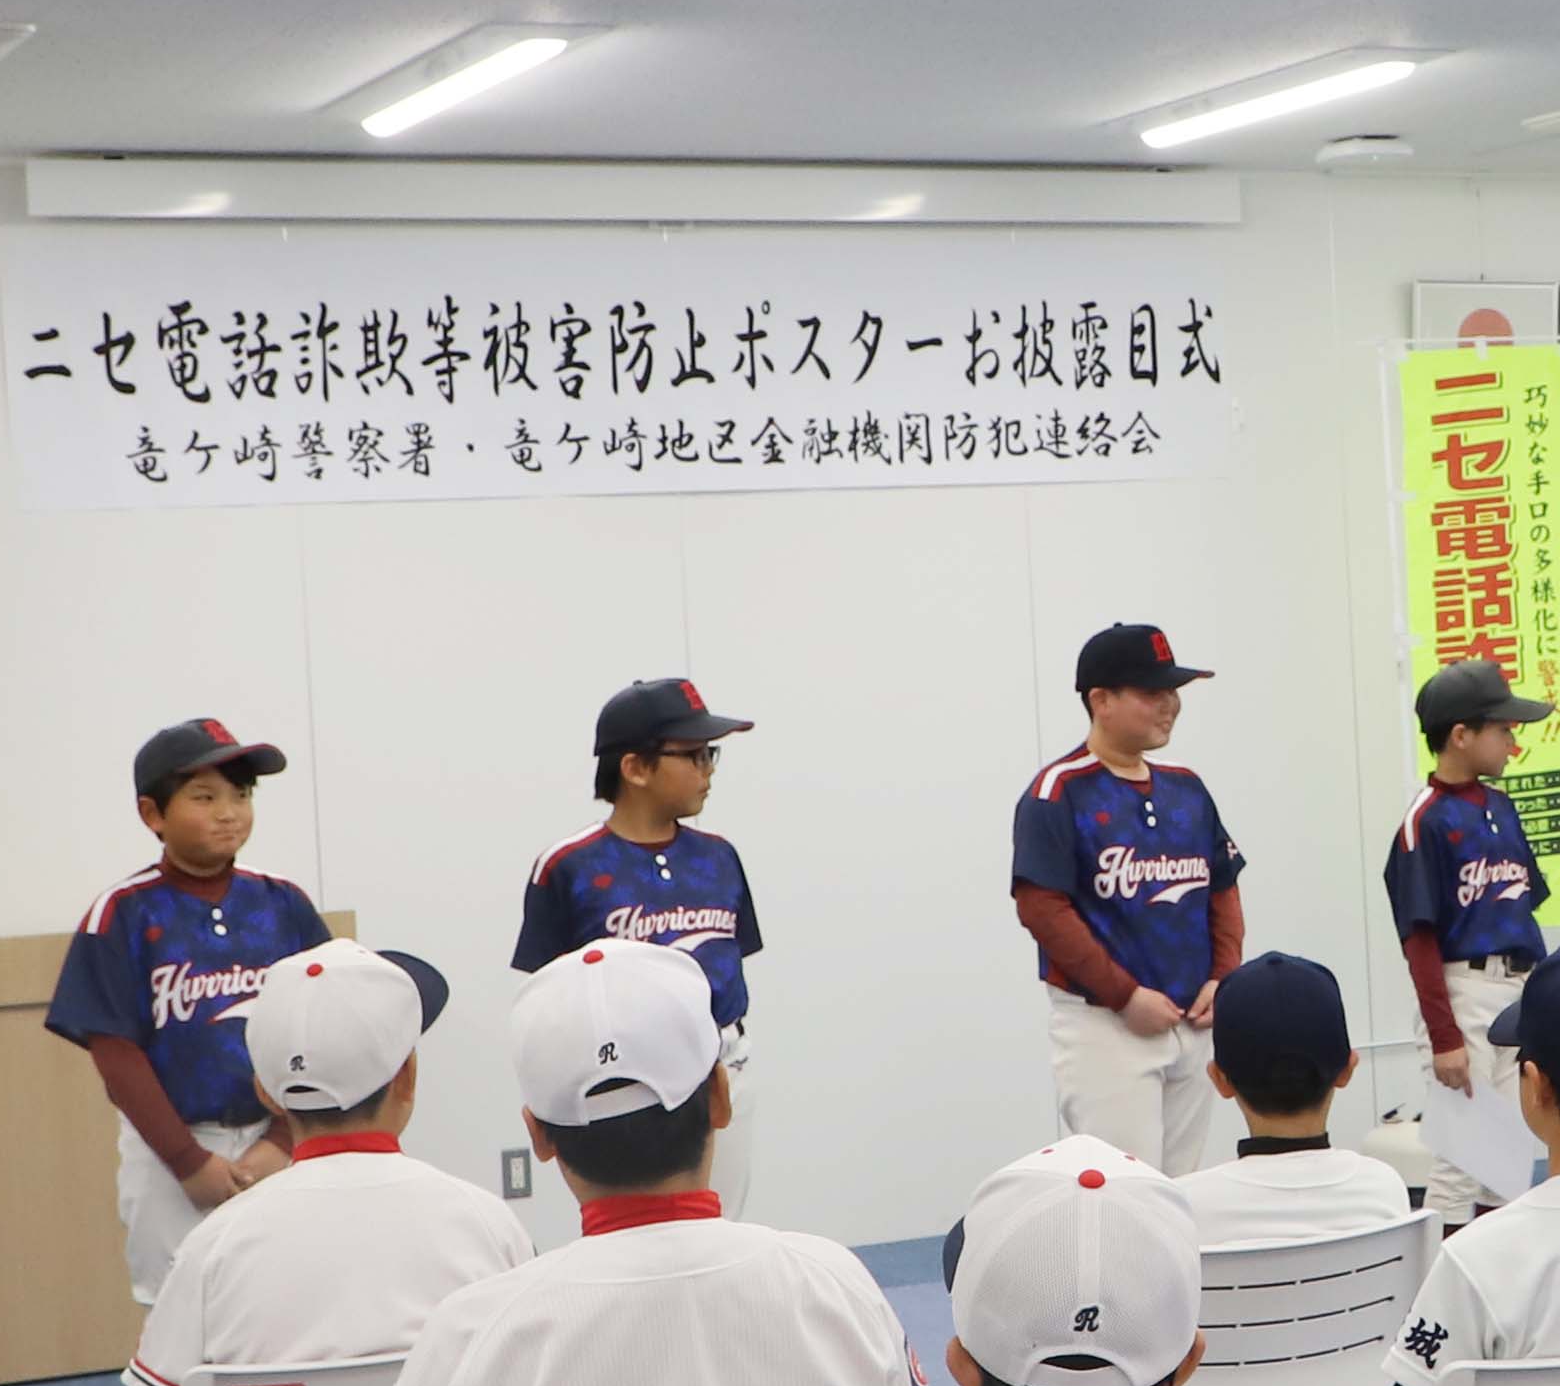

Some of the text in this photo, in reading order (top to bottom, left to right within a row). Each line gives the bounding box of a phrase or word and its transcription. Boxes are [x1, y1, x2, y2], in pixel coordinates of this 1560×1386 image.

[24, 295, 1222, 404] ニセ電話詐欺等被害防止ポスターお披露目式
[289, 1054, 306, 1072] R
[598, 1042, 618, 1065] R
[1073, 1305, 1099, 1333] R
